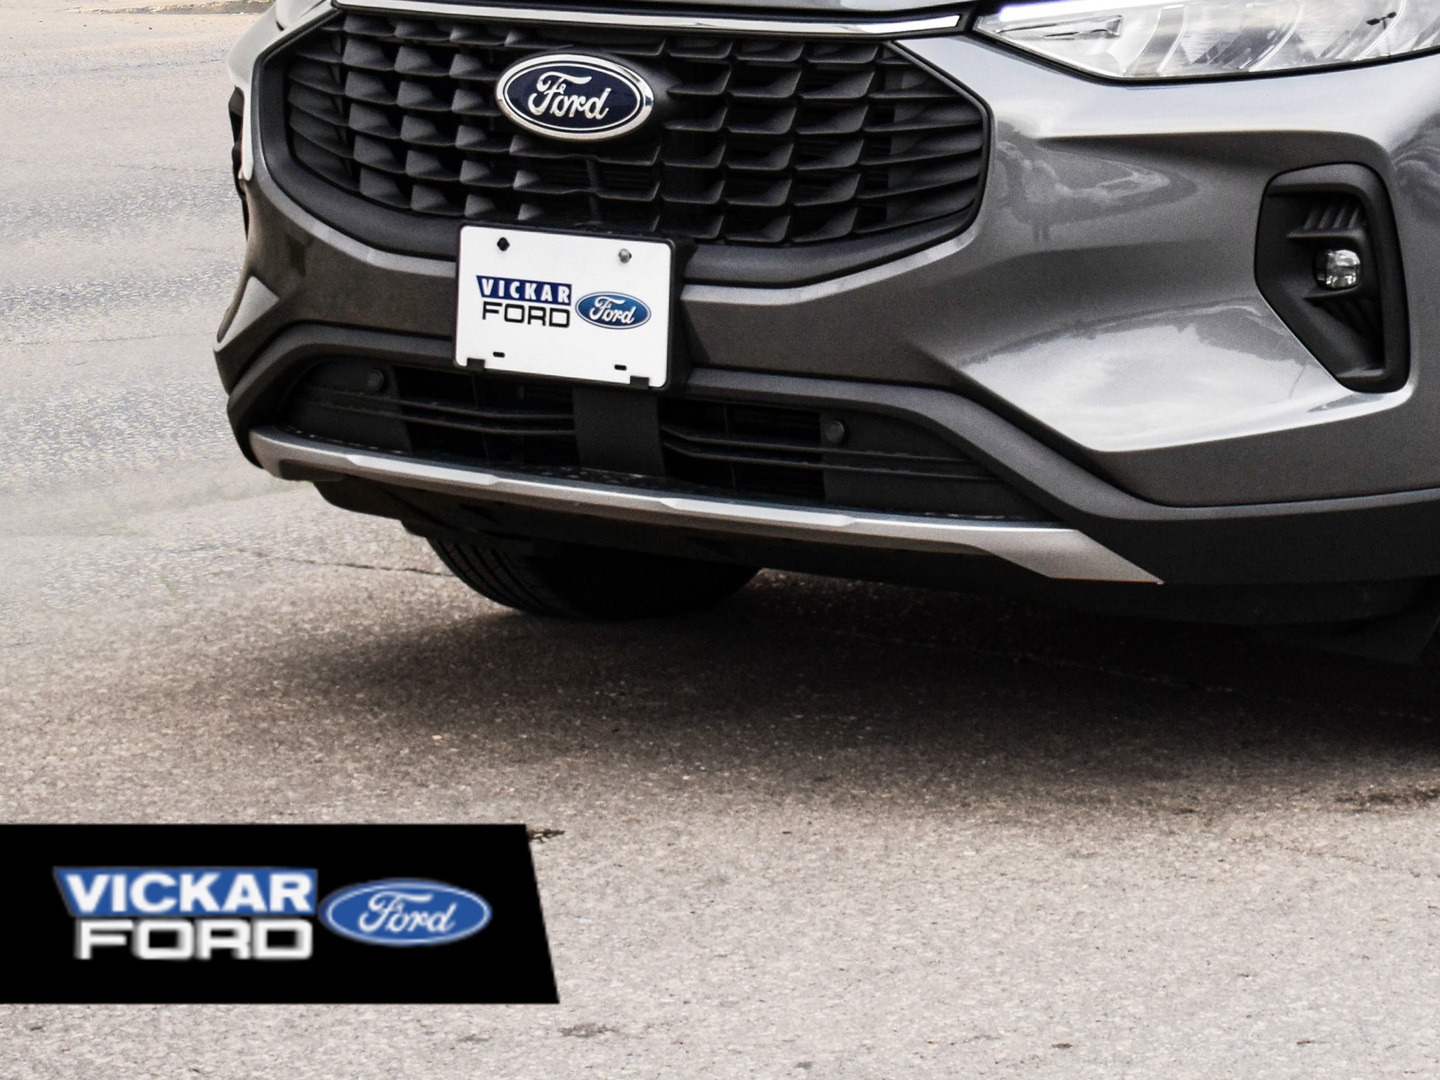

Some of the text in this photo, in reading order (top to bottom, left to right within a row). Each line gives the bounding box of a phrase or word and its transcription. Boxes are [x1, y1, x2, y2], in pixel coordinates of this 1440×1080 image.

[527, 70, 612, 120] Ford
[480, 277, 571, 304] VICKAR
[482, 301, 571, 328] FORD
[589, 296, 636, 325] Ford
